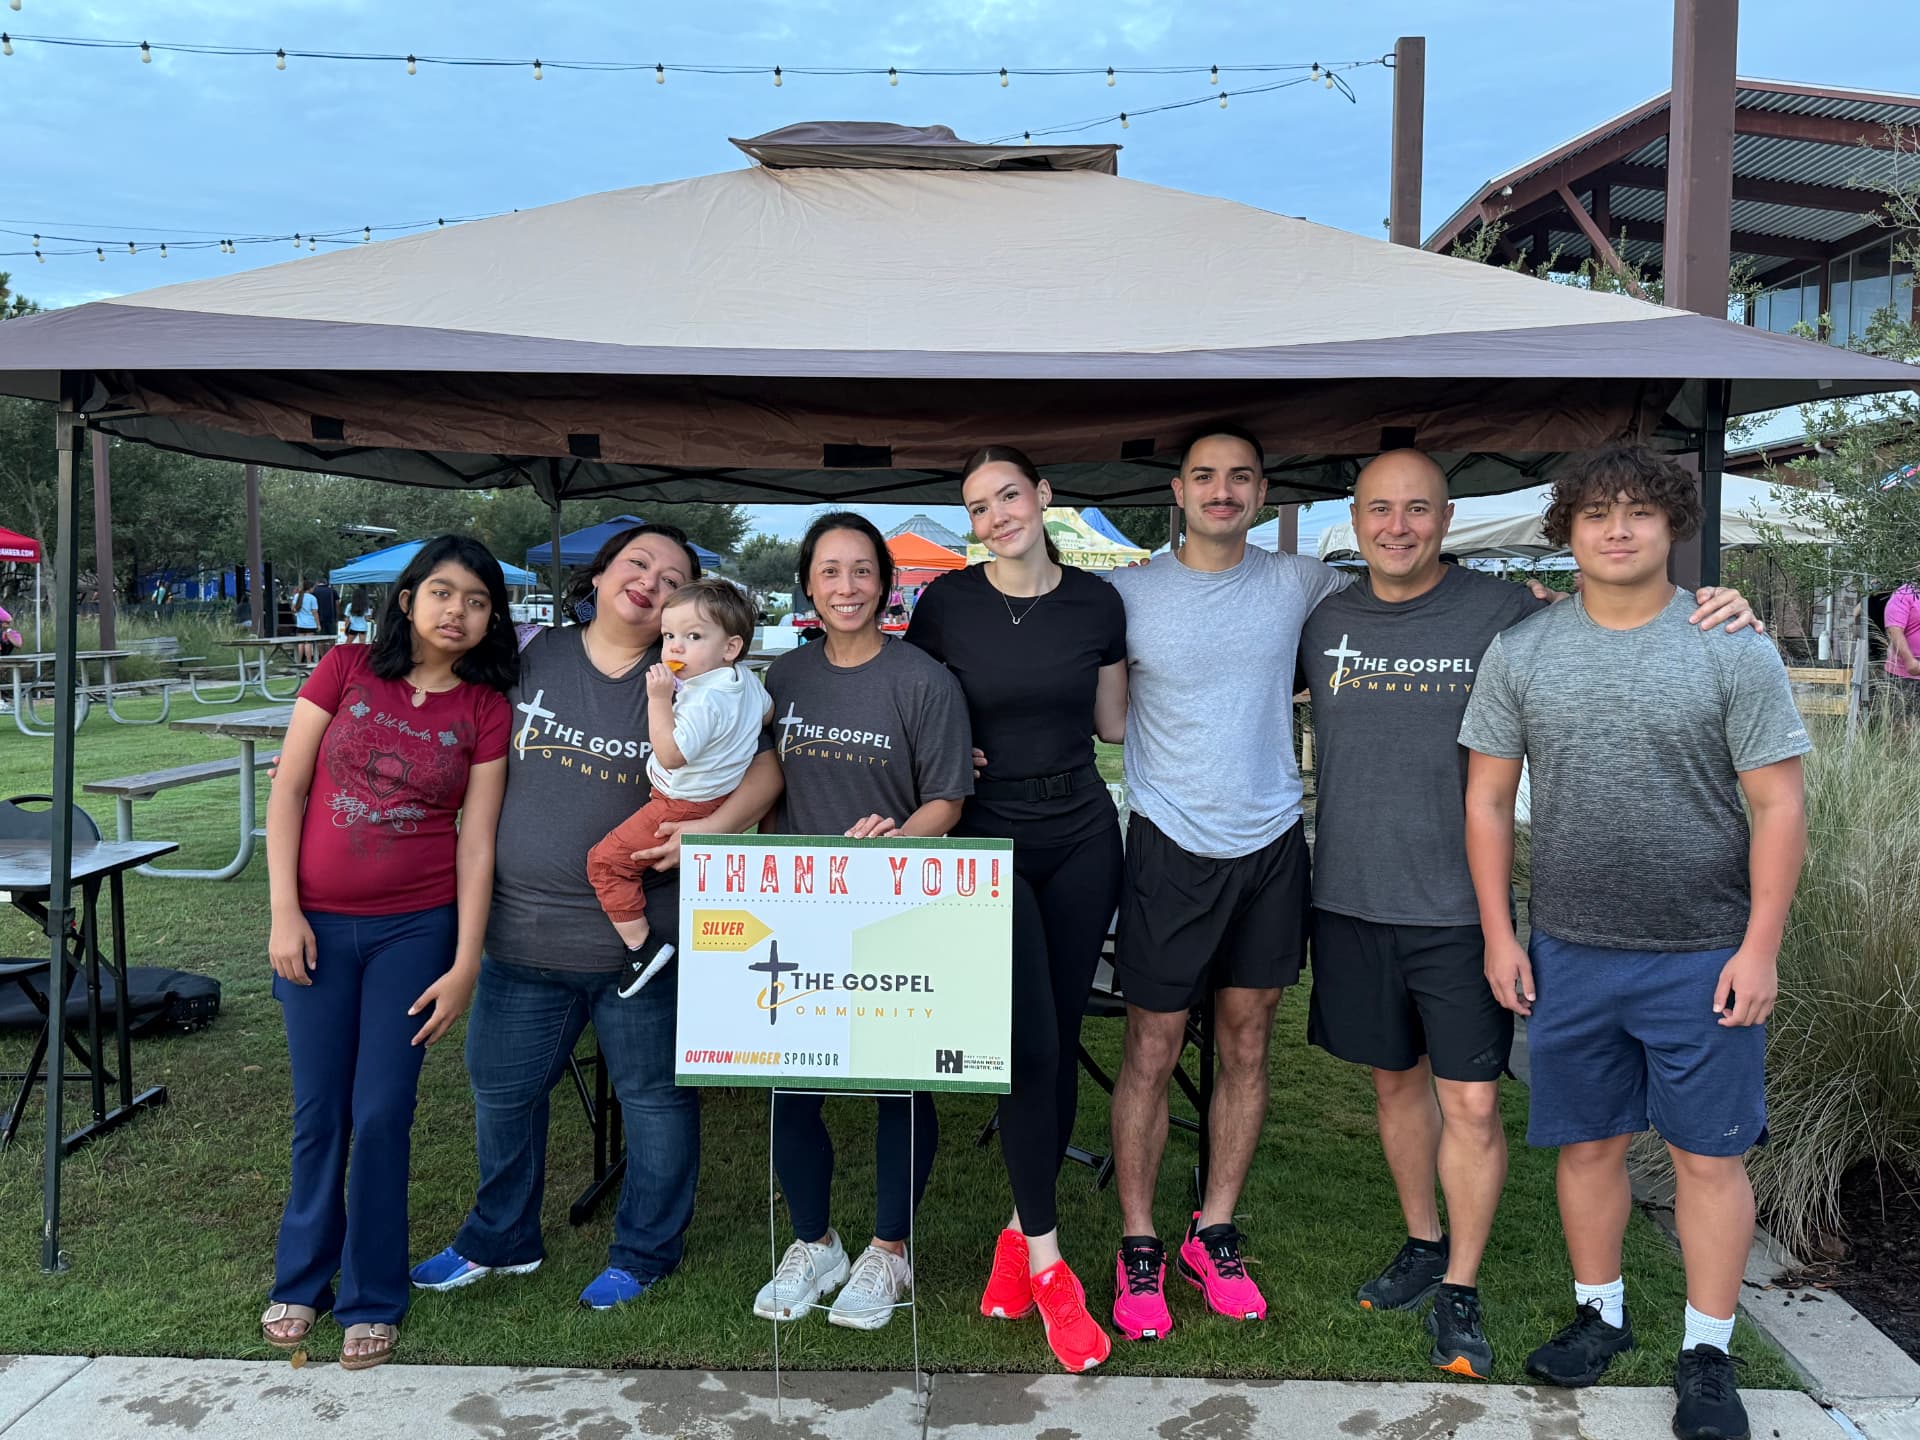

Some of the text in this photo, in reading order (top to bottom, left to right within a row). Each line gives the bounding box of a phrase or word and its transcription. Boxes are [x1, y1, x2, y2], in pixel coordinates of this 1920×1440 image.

[1352, 657, 1474, 673] THE GOSPEL
[544, 719, 653, 759] THE GOSP
[795, 724, 892, 750] THE GOSPEL
[693, 853, 1000, 898] THANK YOU!
[702, 921, 745, 936] SILVER
[790, 972, 935, 993] THE GOSPEL
[784, 1052, 839, 1066] SPONSOR
